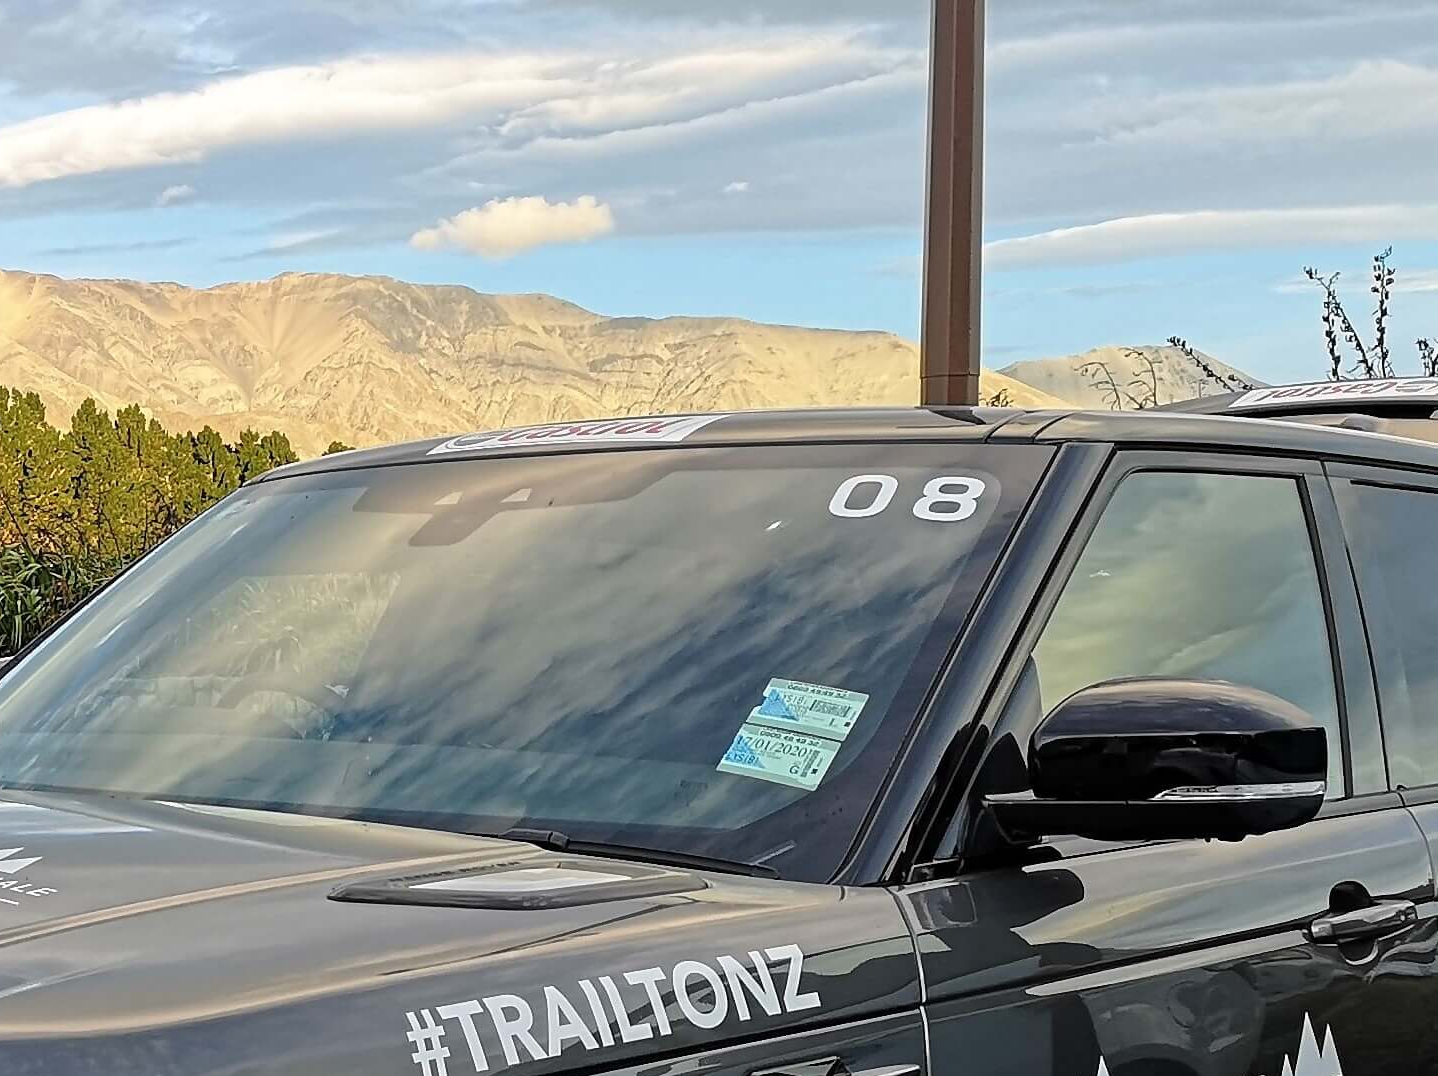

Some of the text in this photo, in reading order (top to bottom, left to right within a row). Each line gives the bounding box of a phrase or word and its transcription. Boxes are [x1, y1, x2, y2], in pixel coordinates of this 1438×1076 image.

[497, 420, 675, 442] Castrol
[827, 474, 986, 522] 08
[736, 734, 808, 759] 17/01/2020
